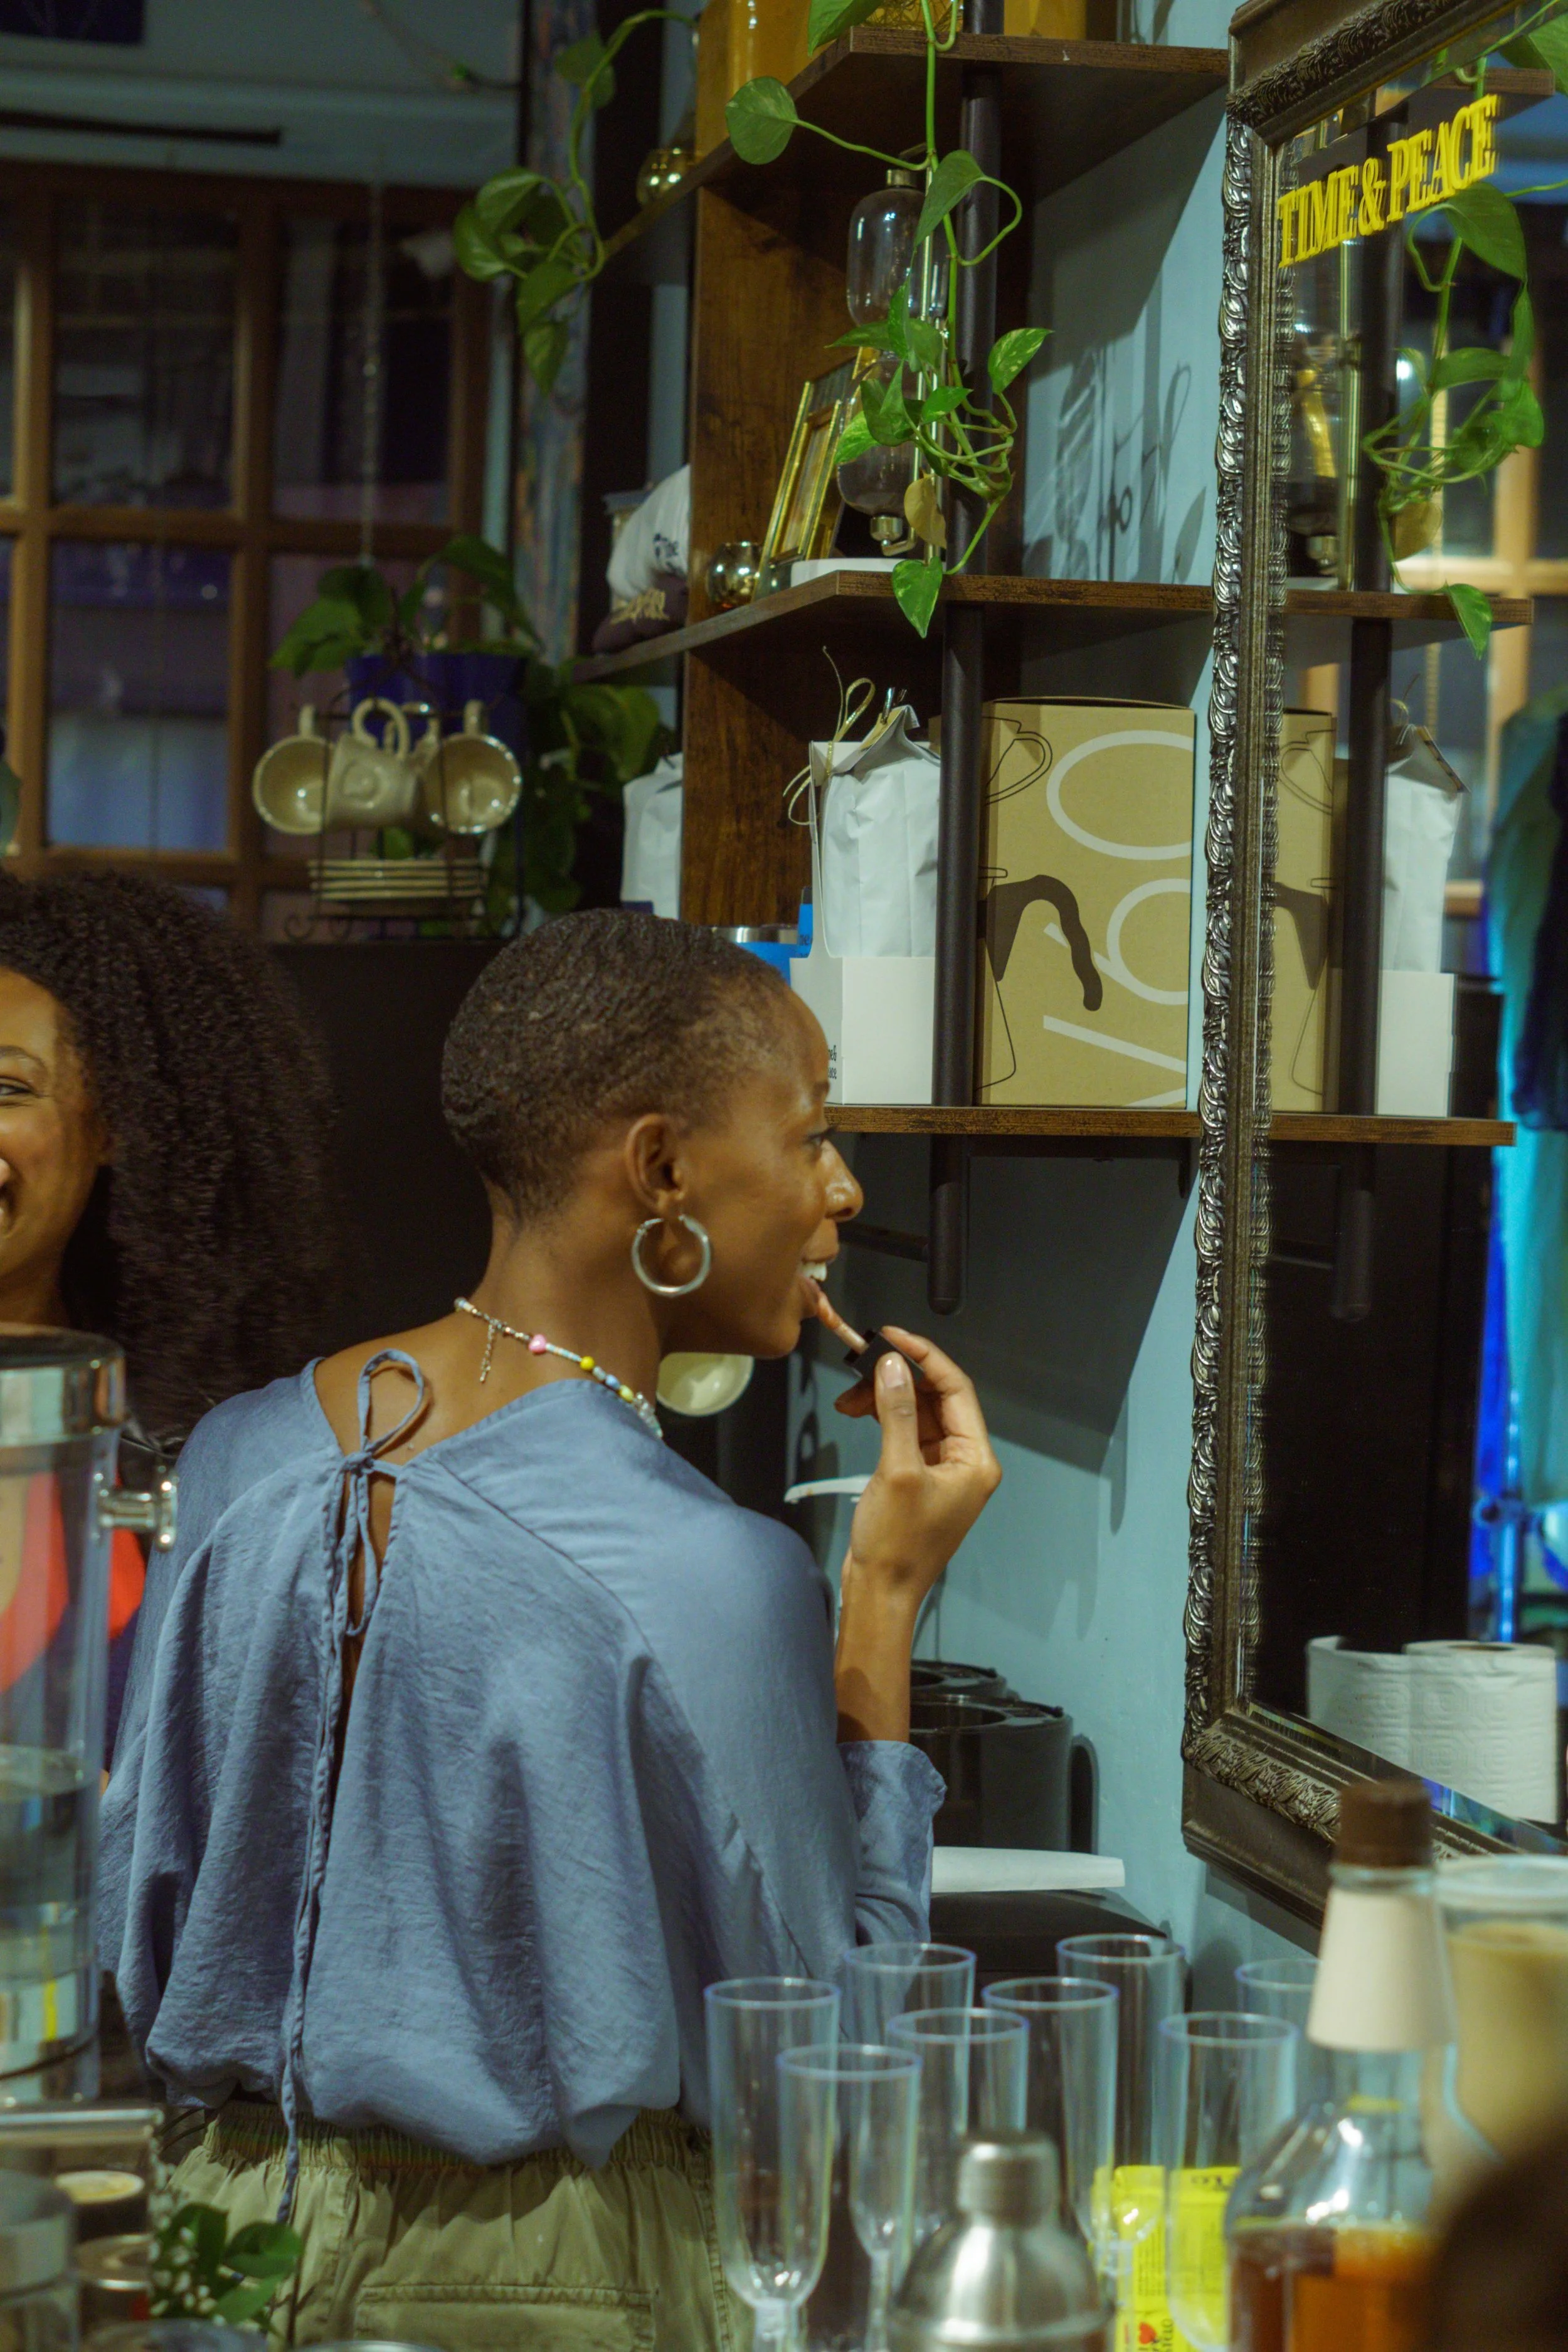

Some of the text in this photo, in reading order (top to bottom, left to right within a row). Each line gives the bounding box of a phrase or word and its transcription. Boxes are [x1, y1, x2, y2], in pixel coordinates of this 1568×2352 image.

[1278, 93, 1501, 268] TIME & PEACE
